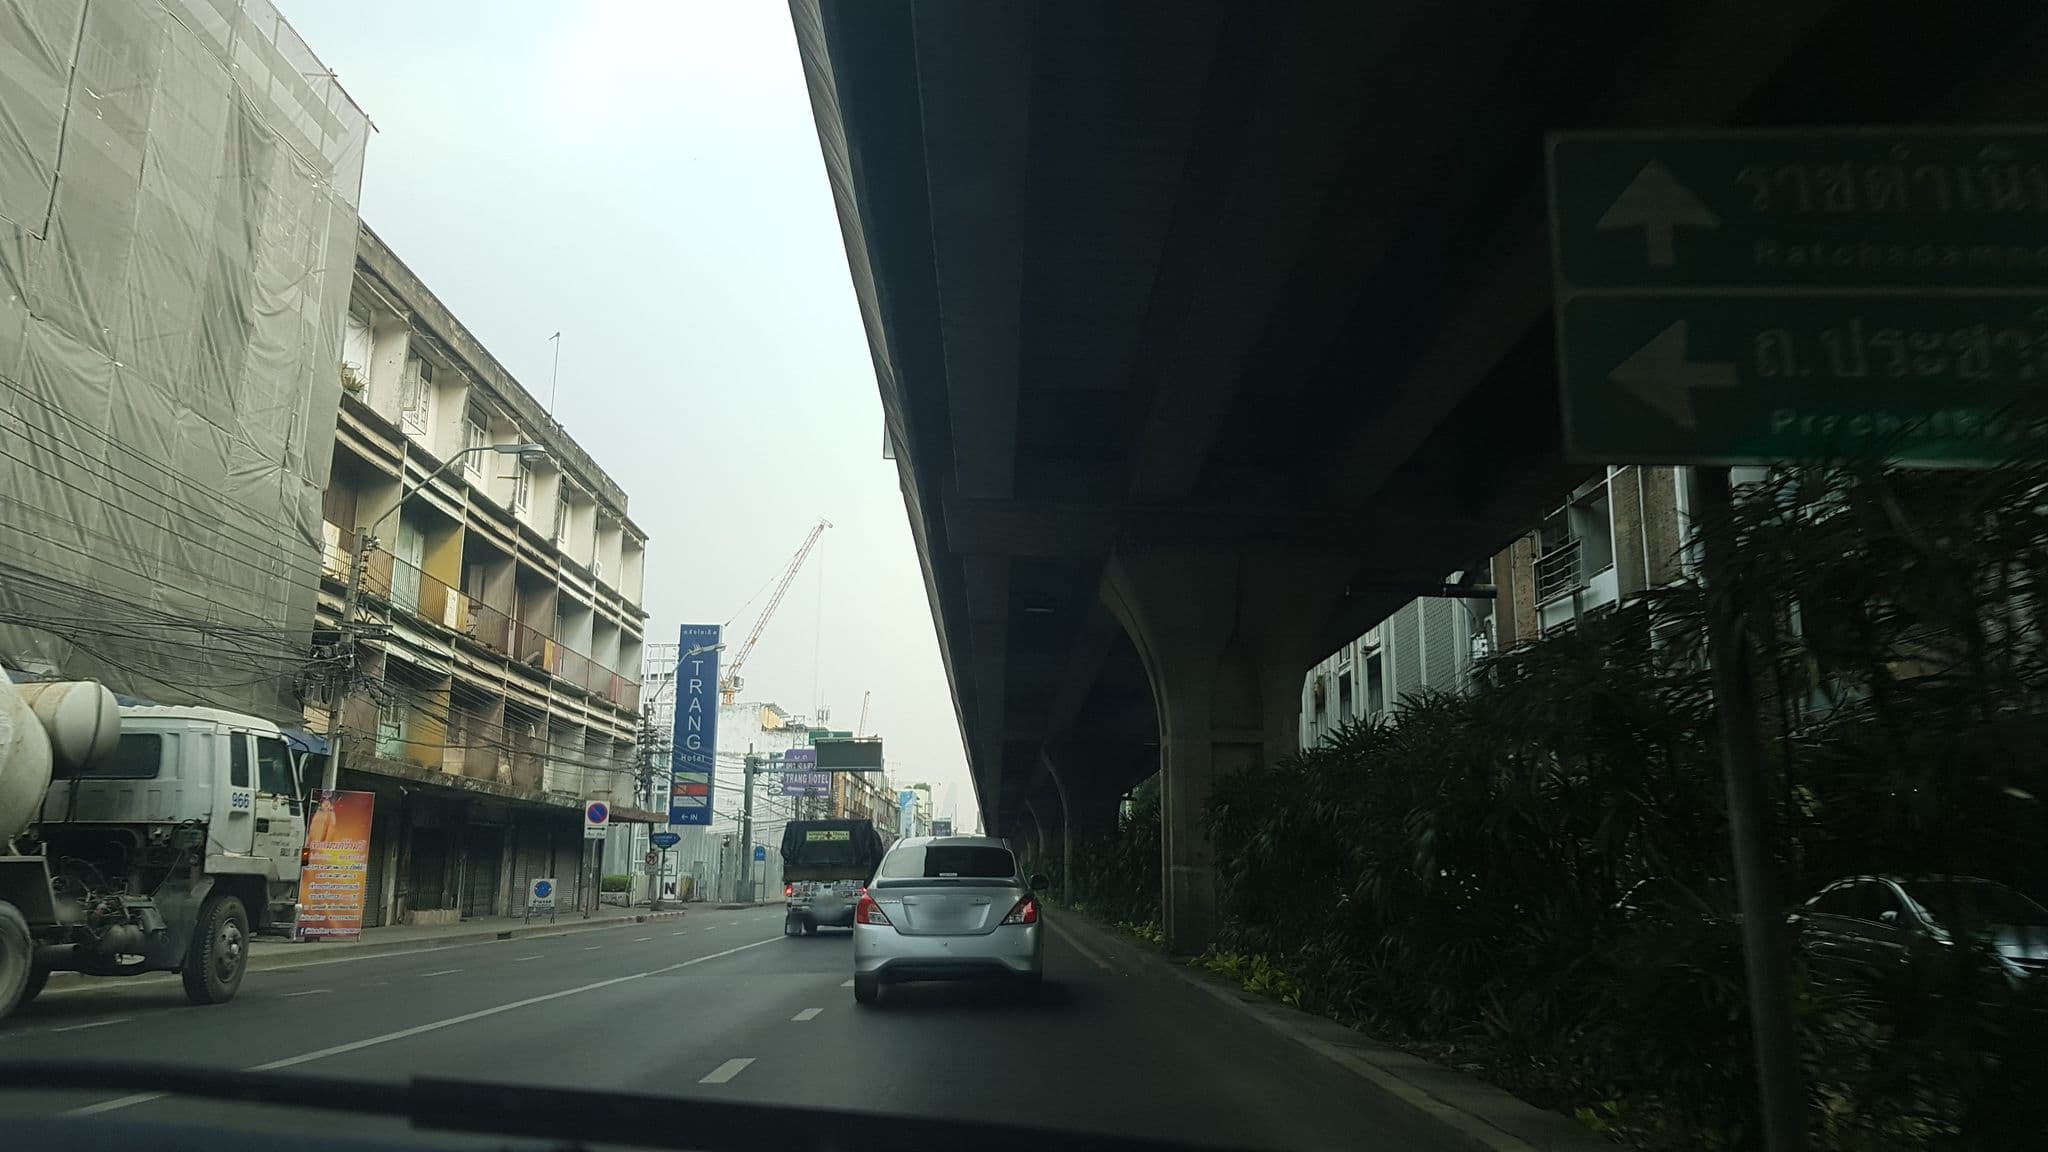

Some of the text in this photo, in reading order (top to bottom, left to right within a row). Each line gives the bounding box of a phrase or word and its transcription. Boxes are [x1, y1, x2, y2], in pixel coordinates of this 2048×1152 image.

[686, 660, 704, 750] TRANG
[680, 753, 706, 763] Hotel
[785, 773, 807, 784] TRANG
[232, 792, 250, 808] 966
[689, 813, 699, 821] IN
